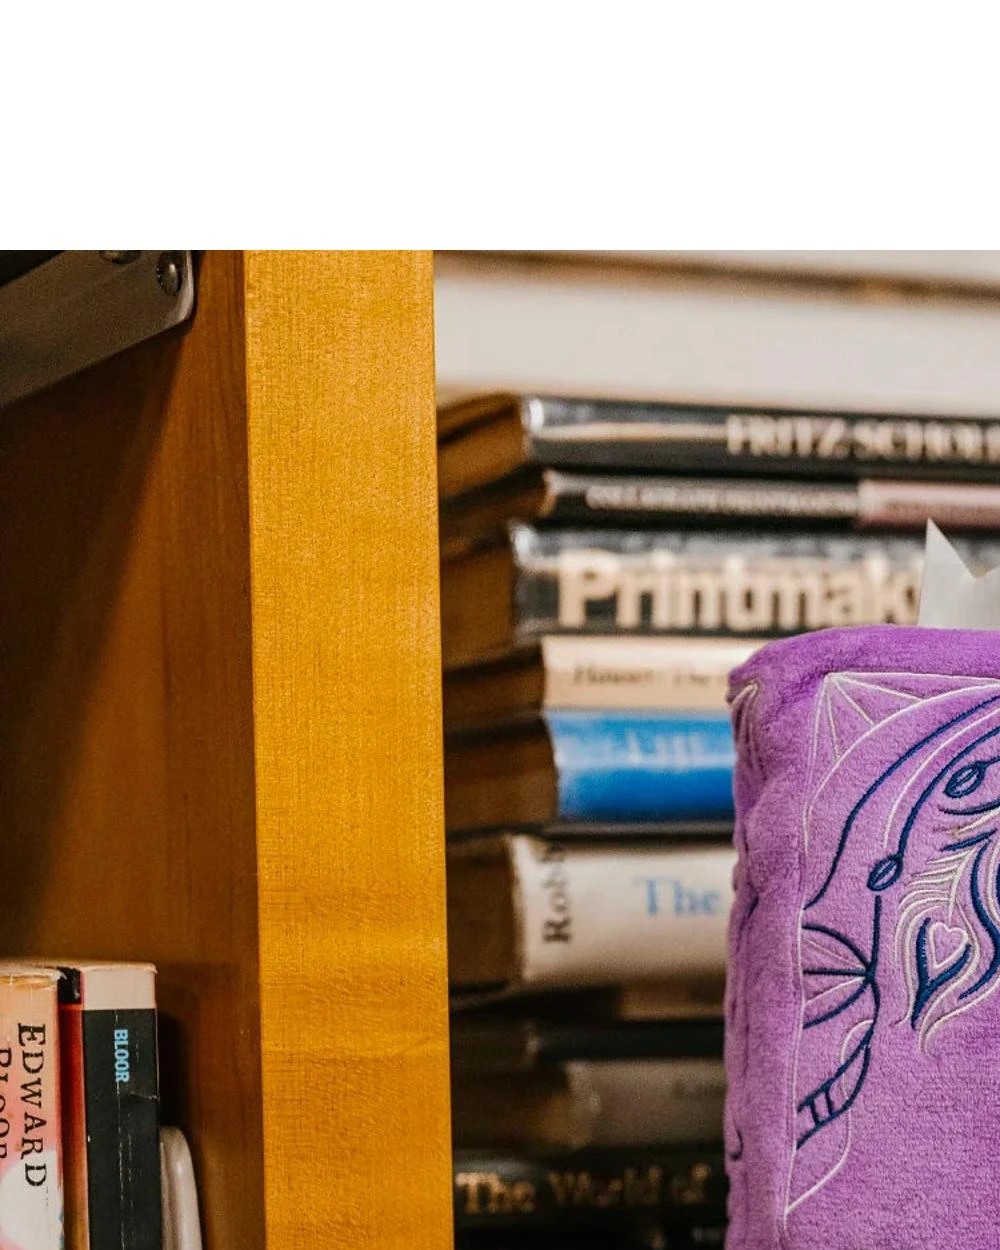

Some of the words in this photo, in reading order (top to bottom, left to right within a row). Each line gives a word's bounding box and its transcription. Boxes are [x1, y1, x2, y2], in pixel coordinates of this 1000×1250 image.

[630, 874, 721, 917] The
[113, 1028, 130, 1084] BLOOR
[17, 1023, 47, 1187] EDWARD
